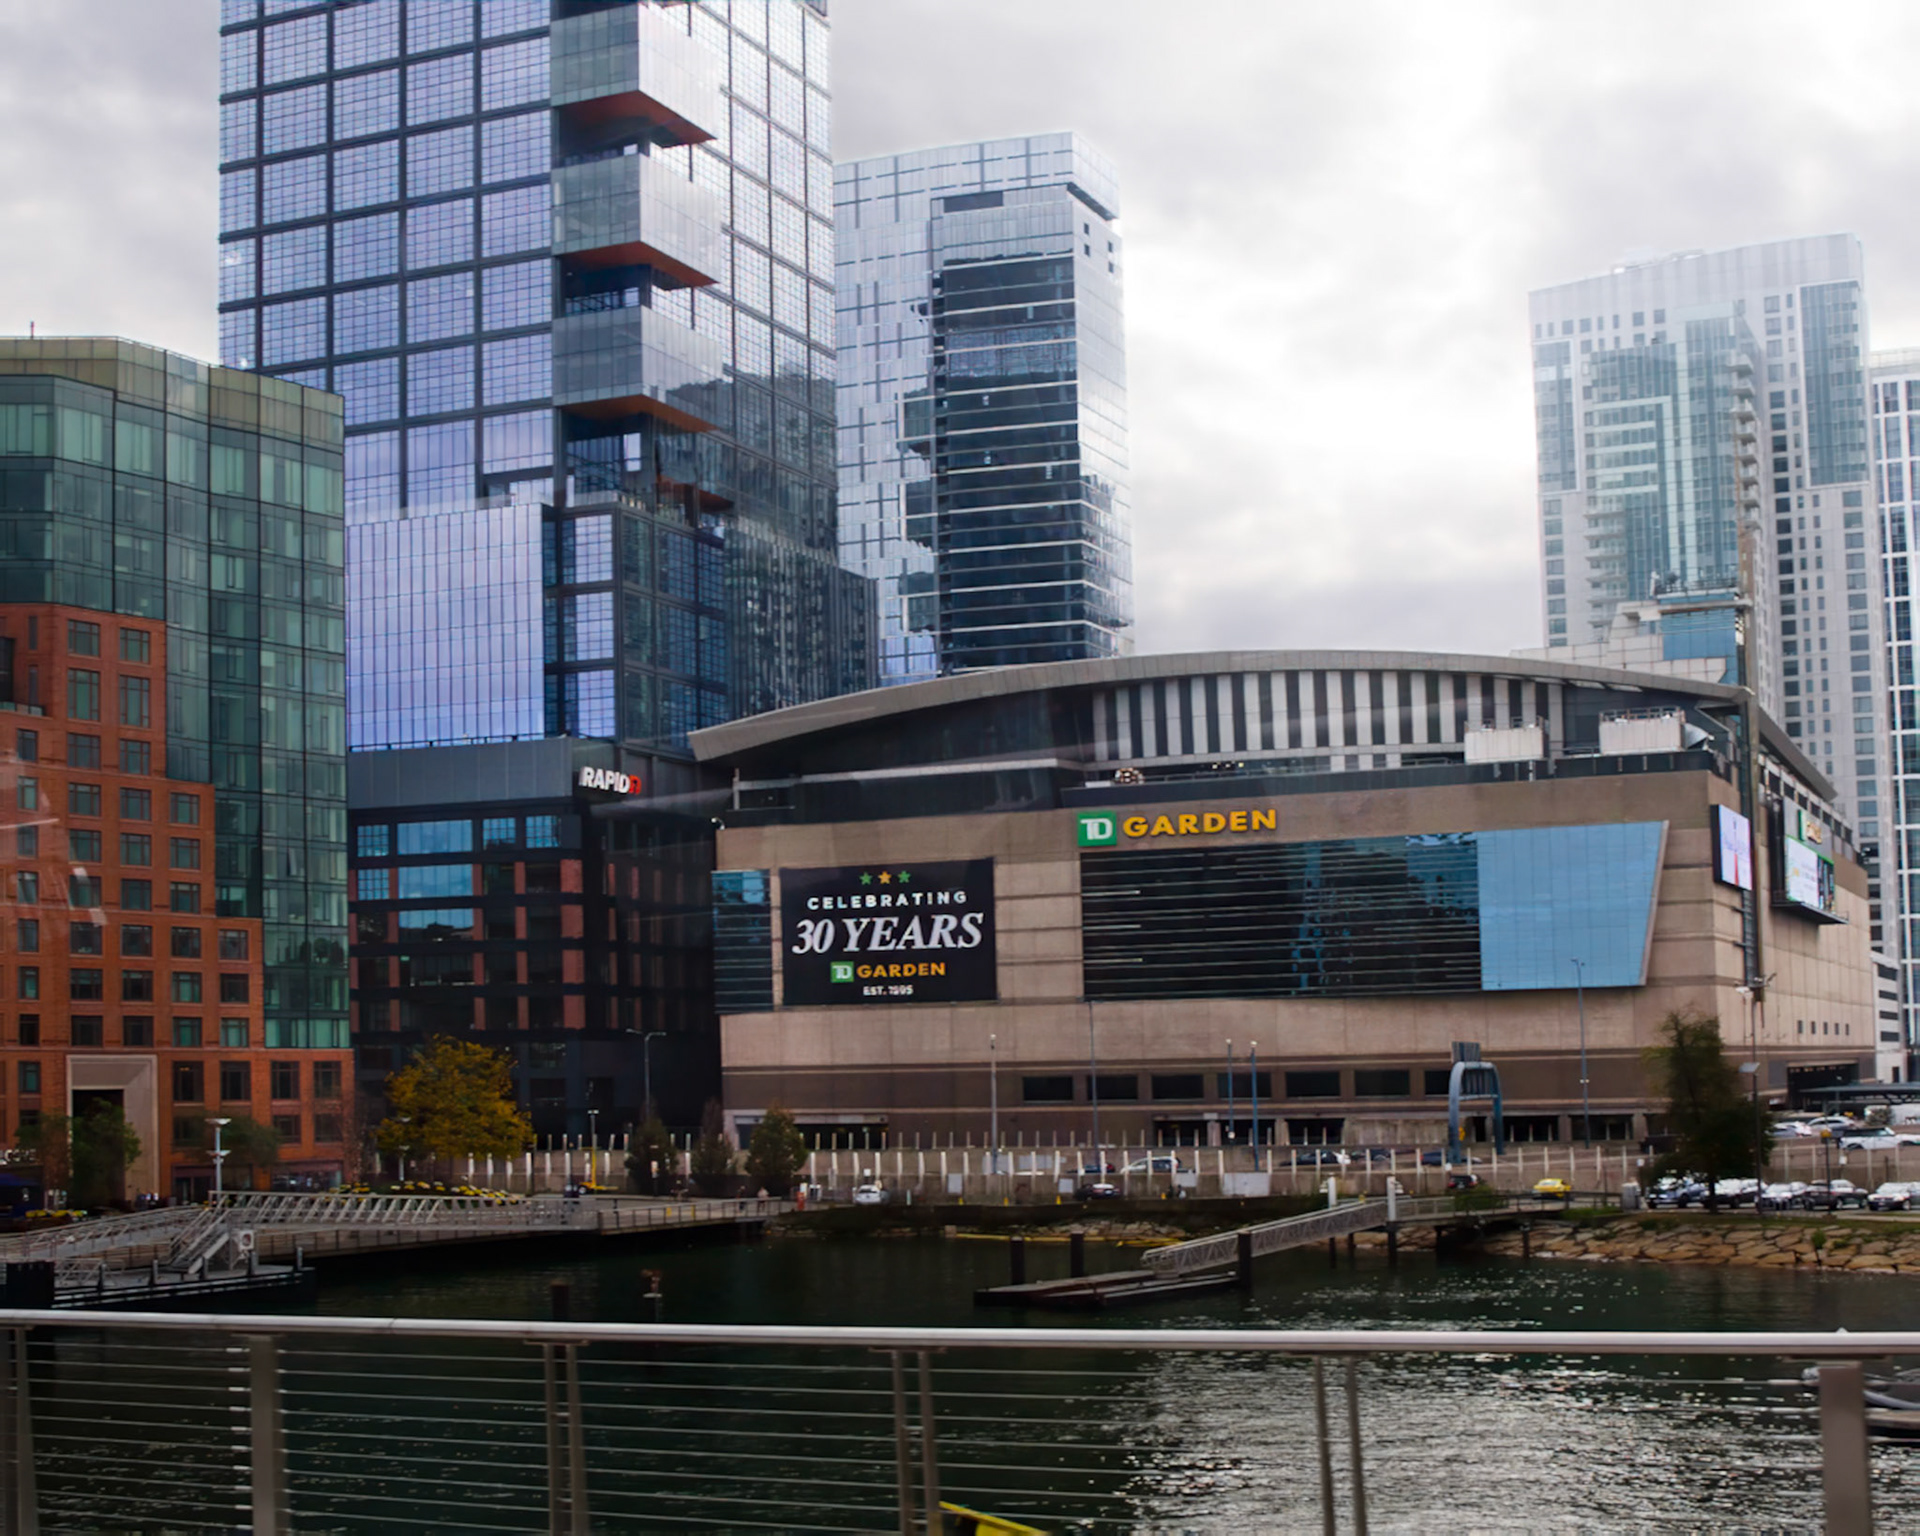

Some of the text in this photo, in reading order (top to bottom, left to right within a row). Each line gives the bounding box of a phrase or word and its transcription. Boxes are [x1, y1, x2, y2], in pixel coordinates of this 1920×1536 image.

[1079, 809, 1277, 842] TD GARDEN
[807, 891, 967, 910] CELEBRATING
[792, 912, 984, 954] 30 YEARS
[831, 962, 946, 981] TD GARDEN
[862, 985, 887, 996] EST.
